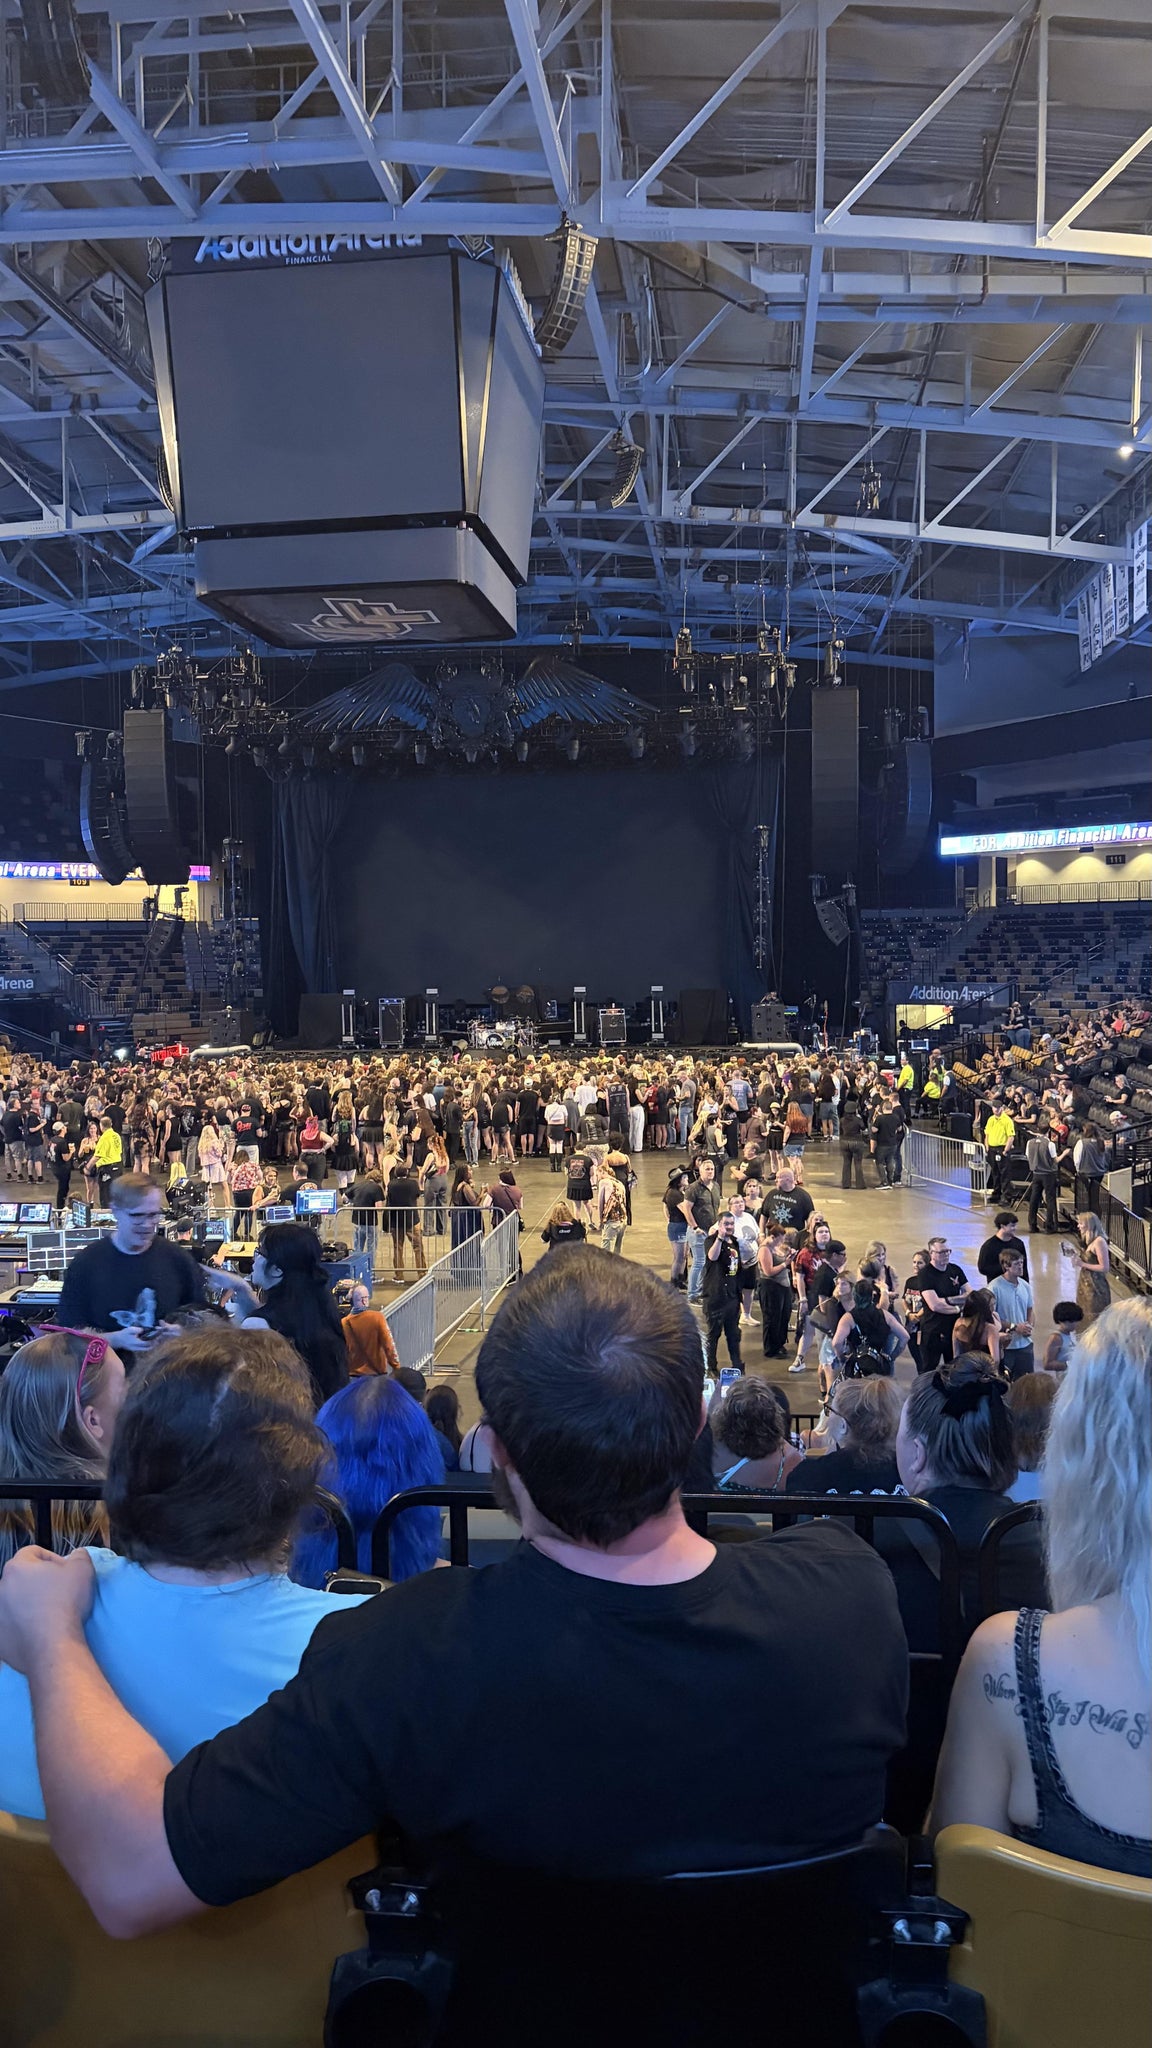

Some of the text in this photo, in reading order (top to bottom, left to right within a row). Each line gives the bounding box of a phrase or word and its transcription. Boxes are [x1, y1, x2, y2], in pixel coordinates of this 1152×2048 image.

[285, 254, 332, 265] FINANCIAL
[1057, 825, 1118, 845] Financial
[1110, 855, 1123, 864] 111
[13, 862, 56, 877] Arena
[72, 878, 87, 886] 109
[1089, 1704, 1129, 1736] Will
